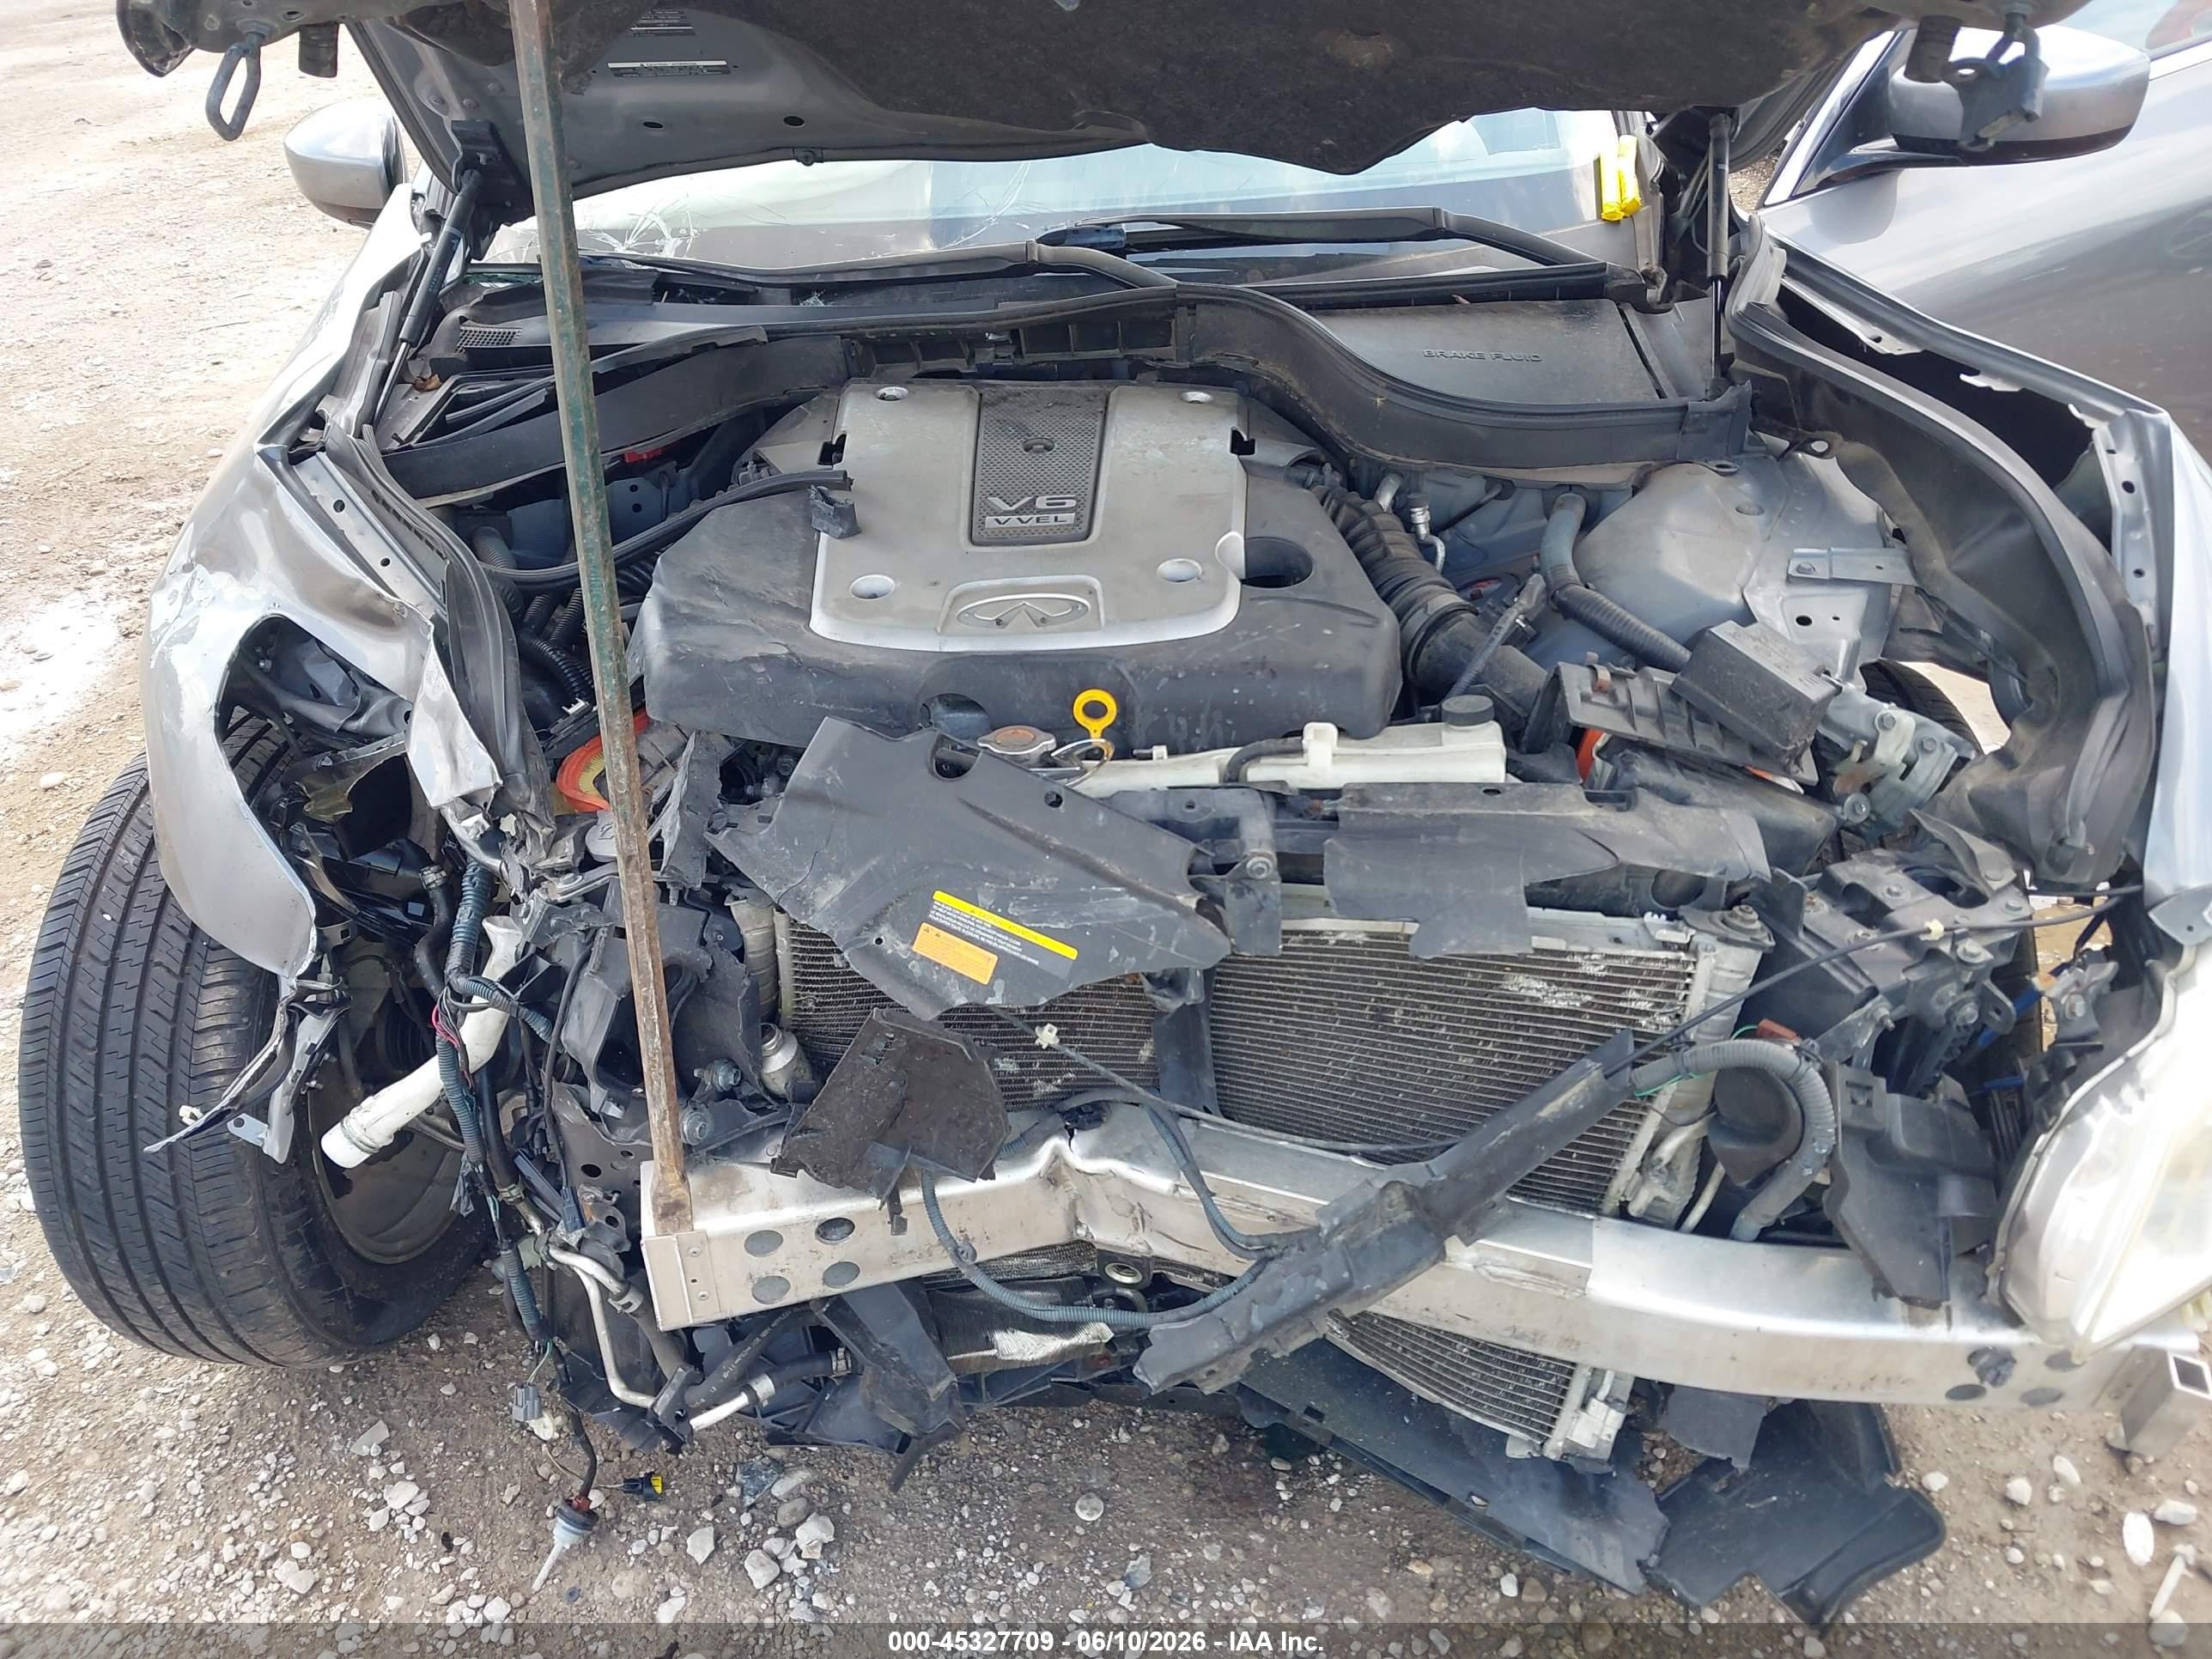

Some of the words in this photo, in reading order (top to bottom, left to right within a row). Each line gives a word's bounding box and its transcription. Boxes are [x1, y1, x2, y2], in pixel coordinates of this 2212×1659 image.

[1422, 349, 1486, 361] BRAKE
[1490, 351, 1543, 362] FLUID
[988, 495, 1077, 513] V6
[994, 515, 1067, 526] VVEL
